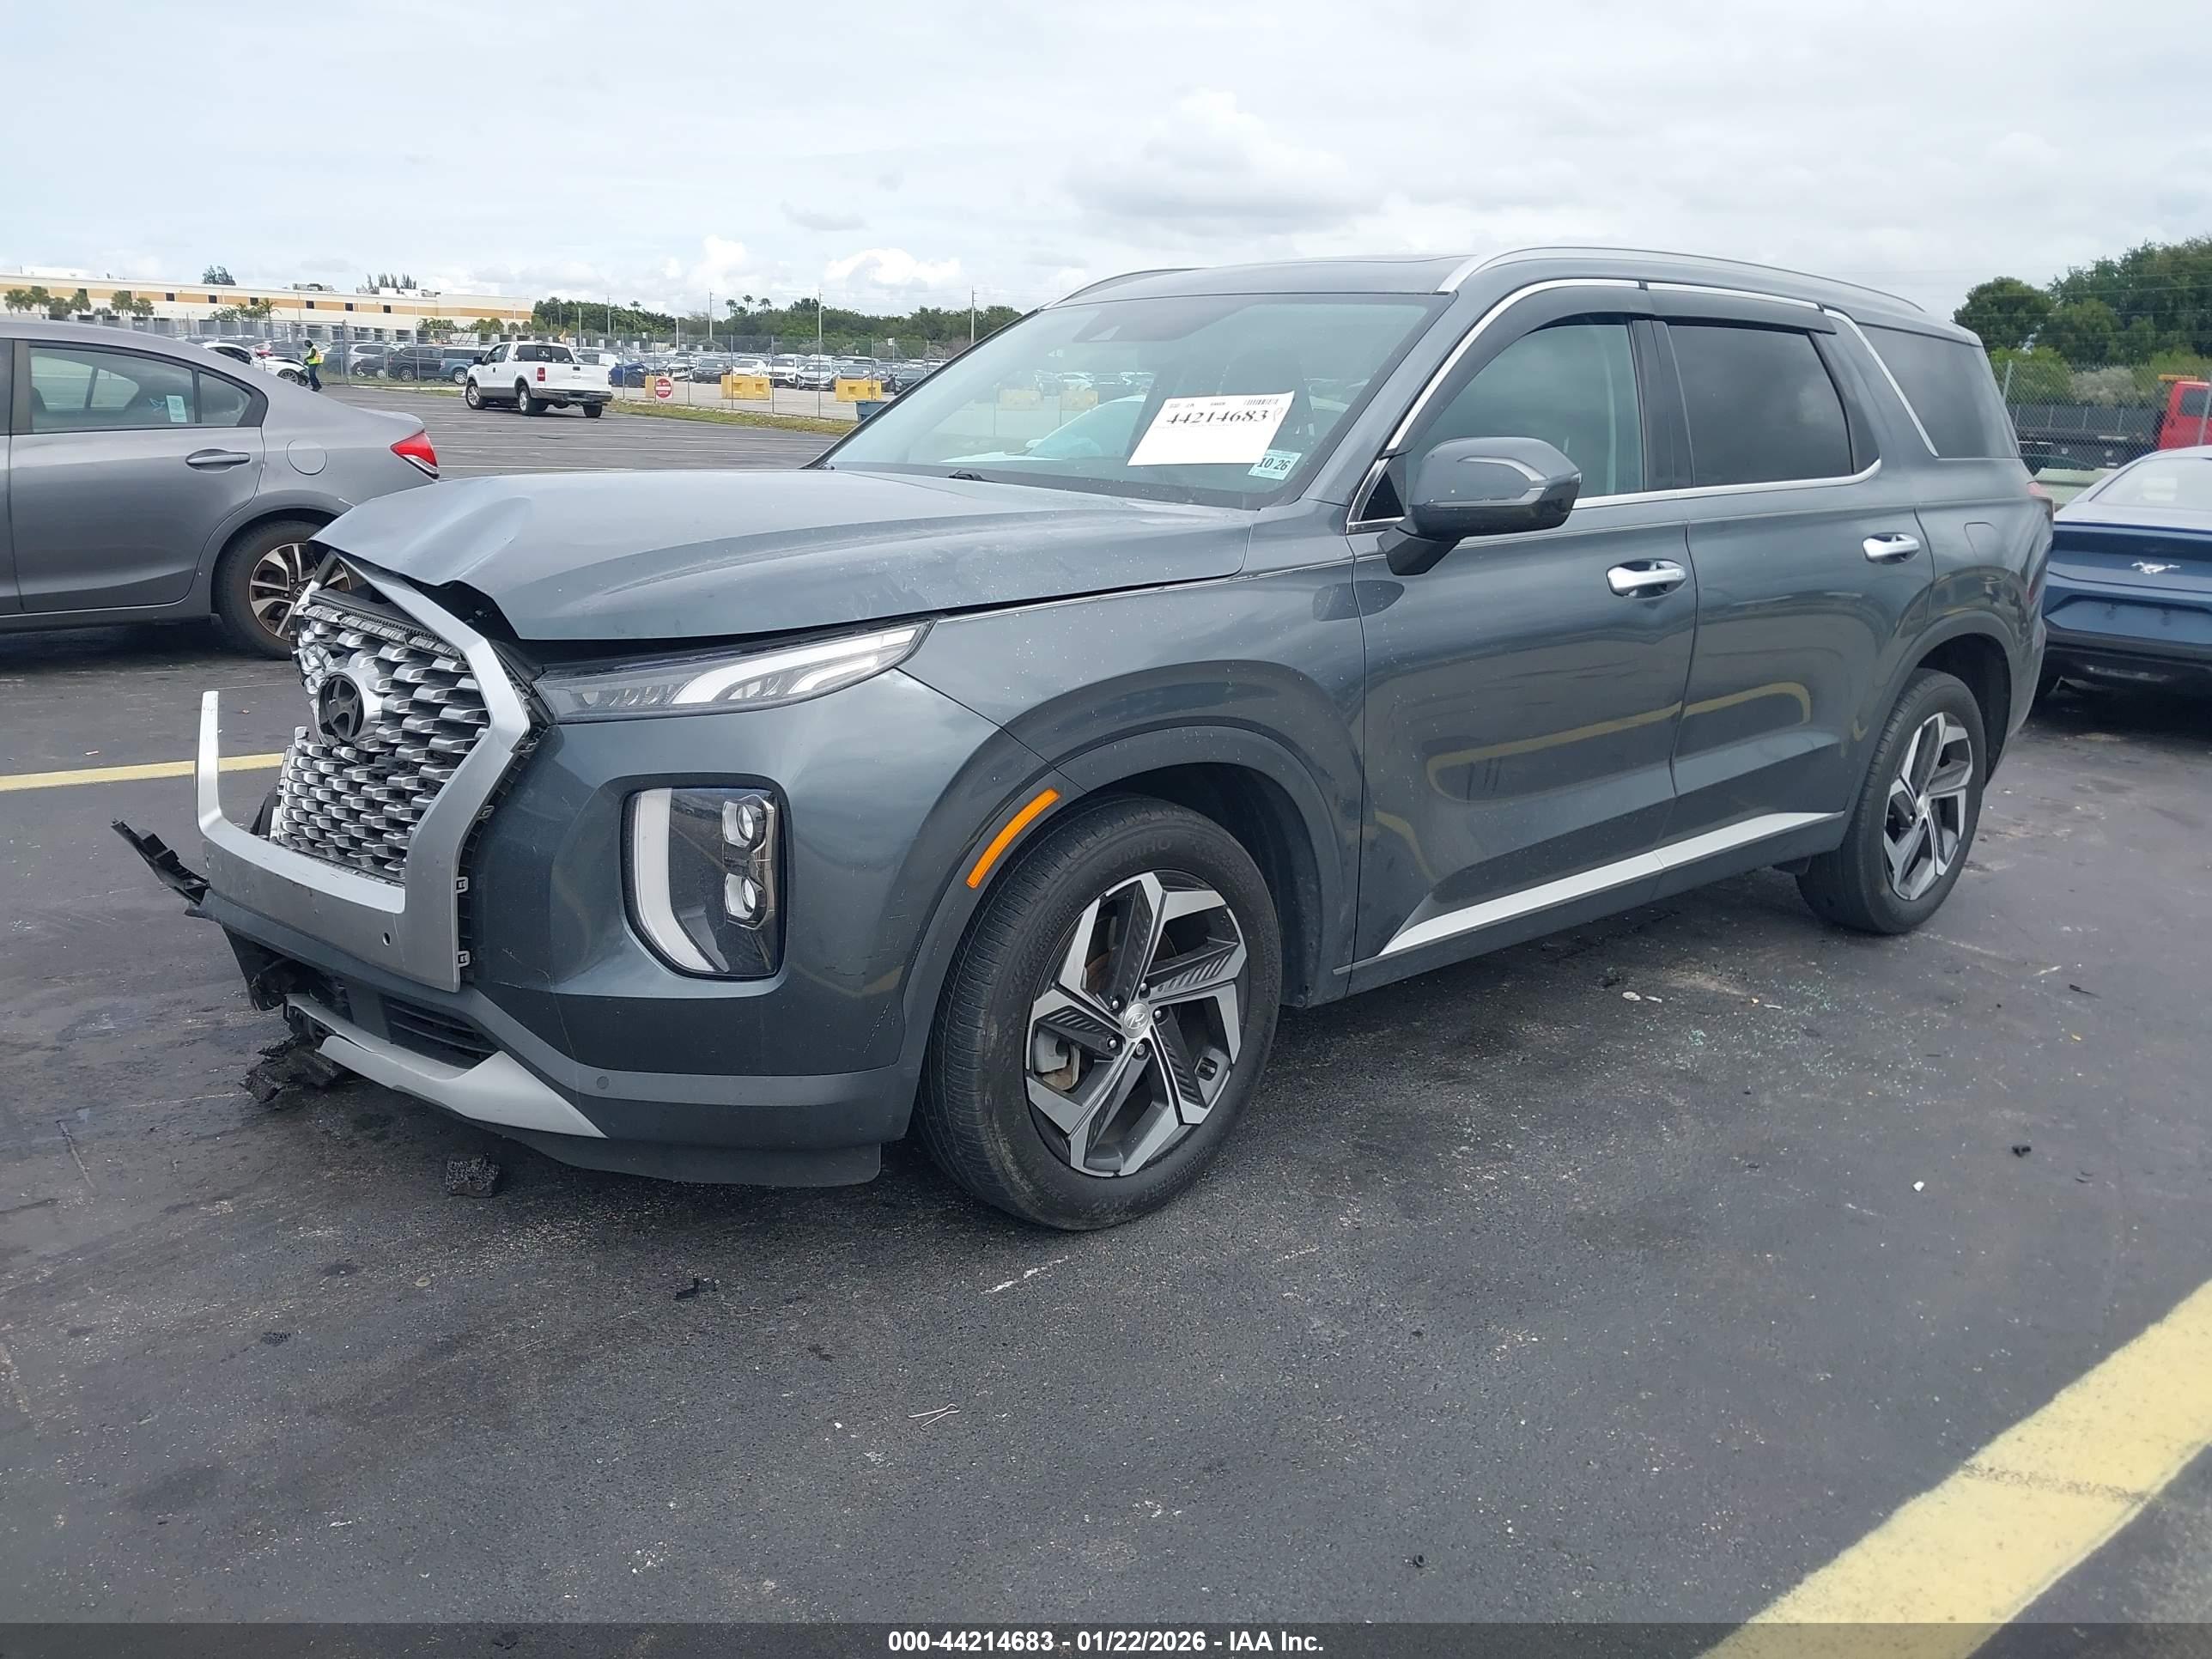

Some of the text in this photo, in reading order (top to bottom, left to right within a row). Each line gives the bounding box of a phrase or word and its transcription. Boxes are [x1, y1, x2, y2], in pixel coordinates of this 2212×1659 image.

[1166, 410, 1268, 424] 44214683
[1257, 457, 1291, 471] 10 26
